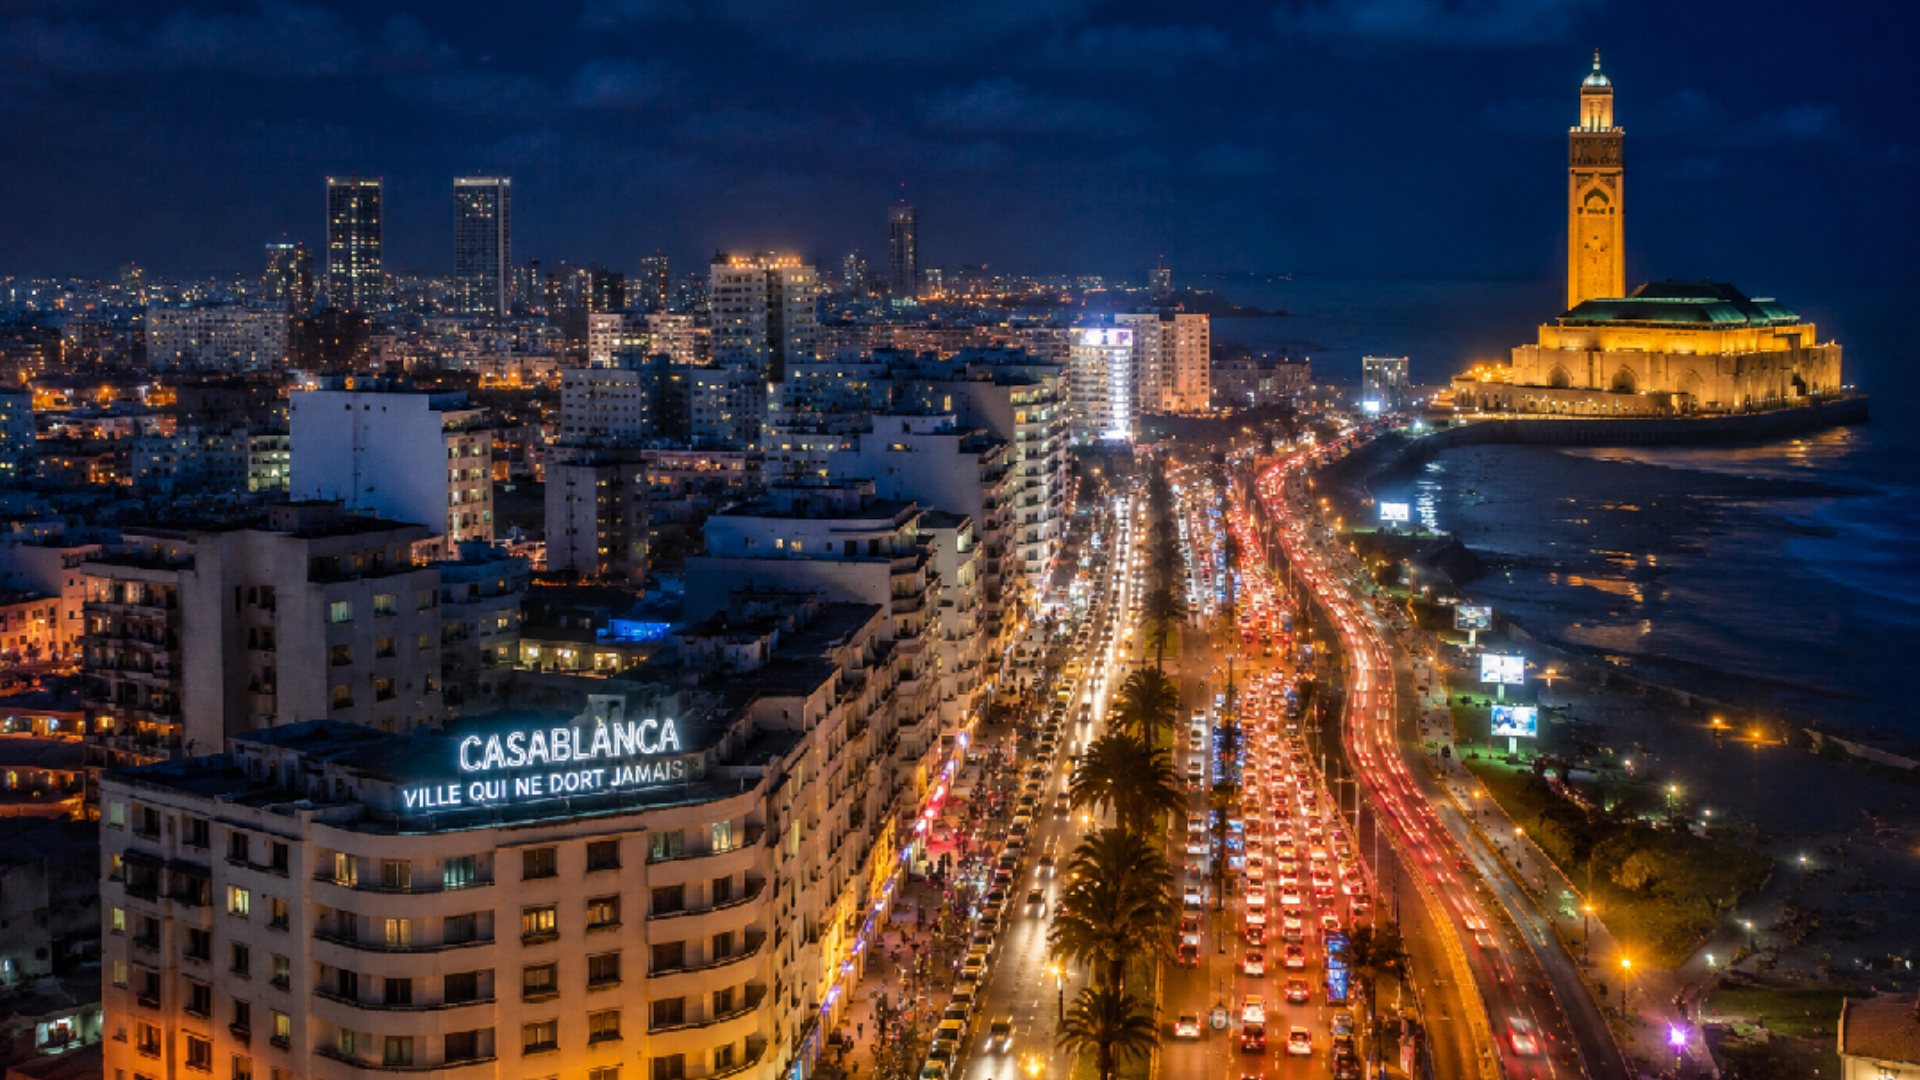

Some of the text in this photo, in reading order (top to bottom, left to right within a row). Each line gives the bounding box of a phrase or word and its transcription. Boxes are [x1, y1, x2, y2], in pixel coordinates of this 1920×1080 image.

[460, 718, 680, 771] CASABLANCA
[403, 760, 683, 808] VILLE QUI NE DORT JAMAIS
